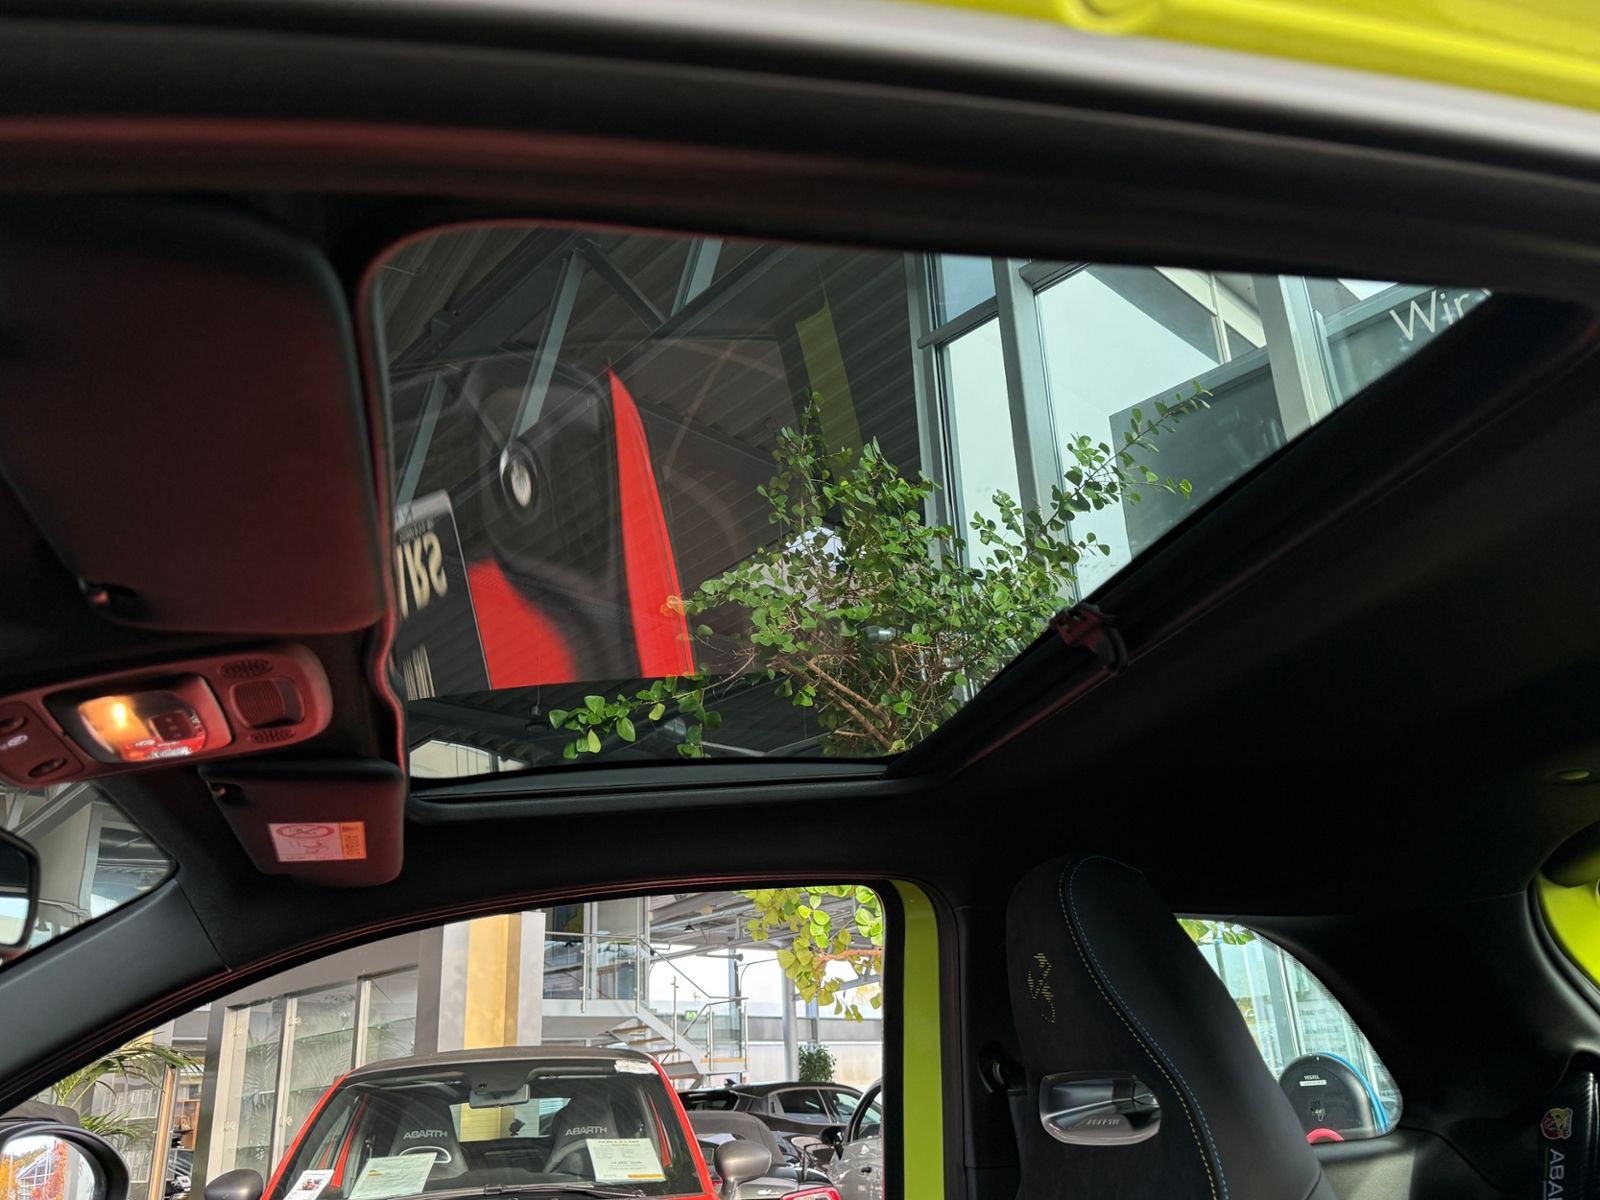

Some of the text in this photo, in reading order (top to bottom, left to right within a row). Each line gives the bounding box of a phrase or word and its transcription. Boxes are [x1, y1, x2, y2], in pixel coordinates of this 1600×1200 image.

[403, 1129, 448, 1139] ABARTH
[565, 1126, 608, 1137] ABARTH
[1547, 1148, 1565, 1200] ABA
